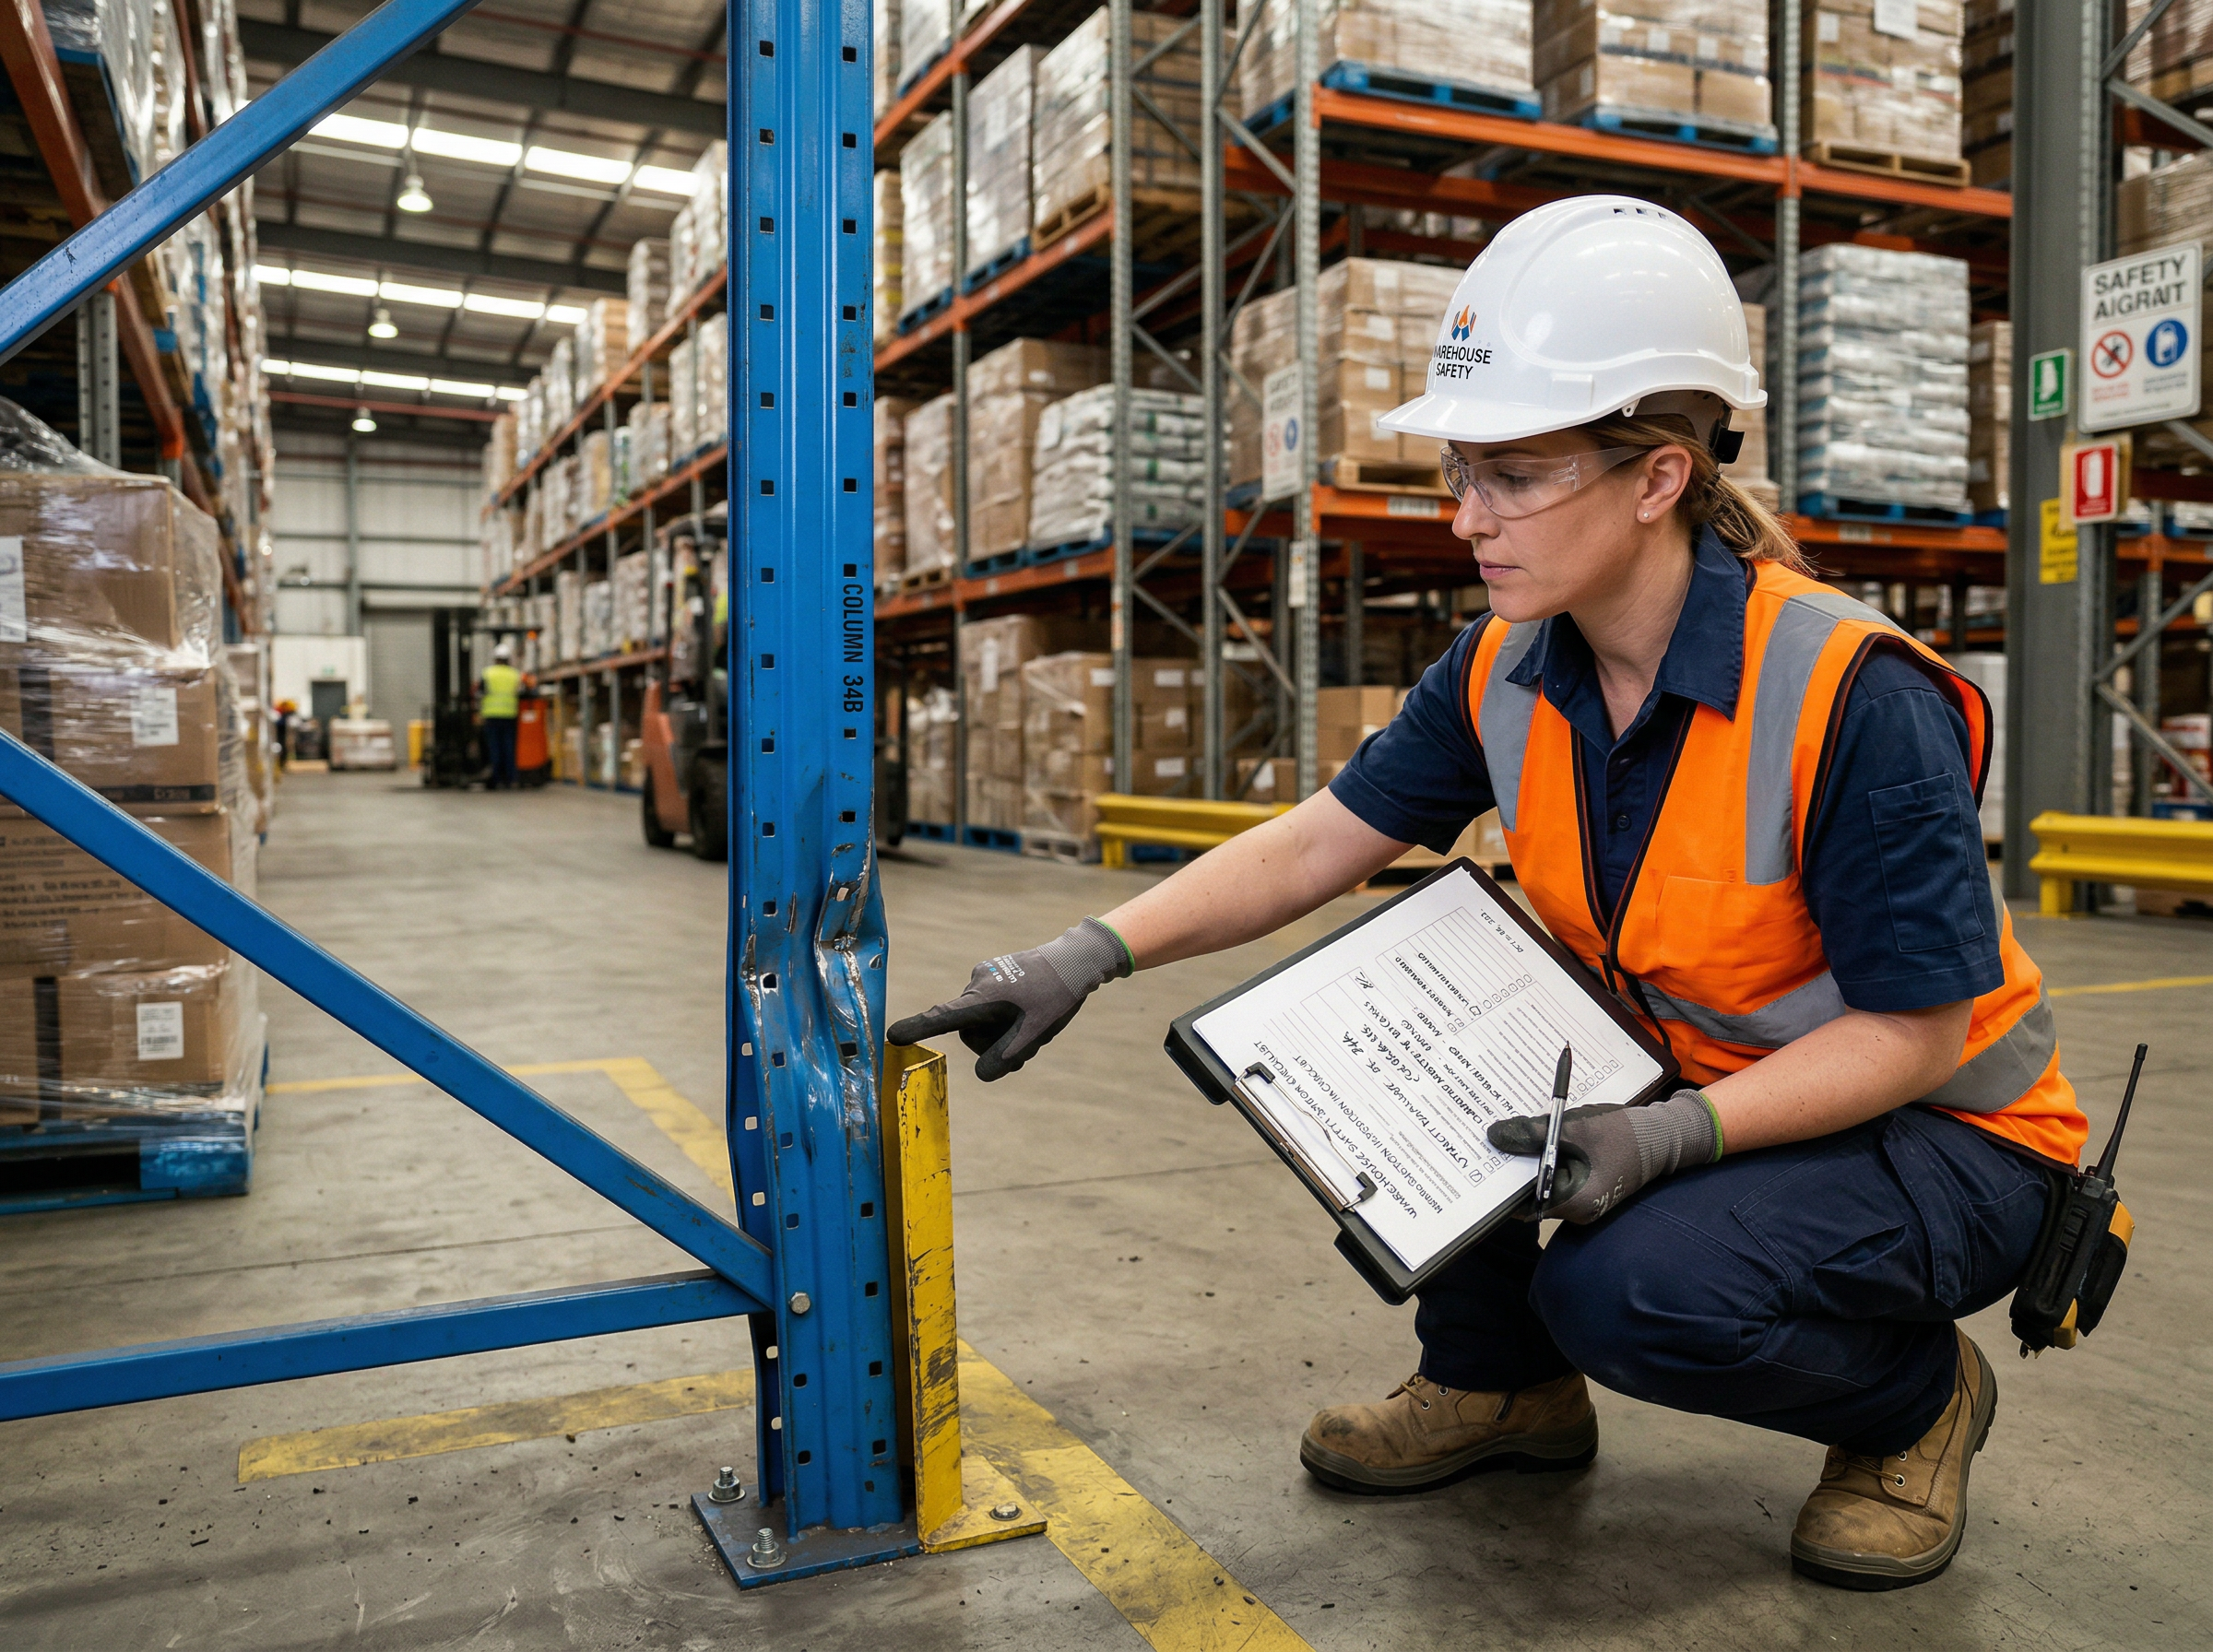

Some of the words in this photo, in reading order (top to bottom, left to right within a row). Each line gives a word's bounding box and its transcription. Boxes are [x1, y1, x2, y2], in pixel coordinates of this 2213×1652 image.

[2094, 254, 2186, 296] SAFETY
[1436, 362, 1473, 380] SAFETY
[842, 584, 864, 663] COLUMN
[842, 675, 864, 714] 34B
